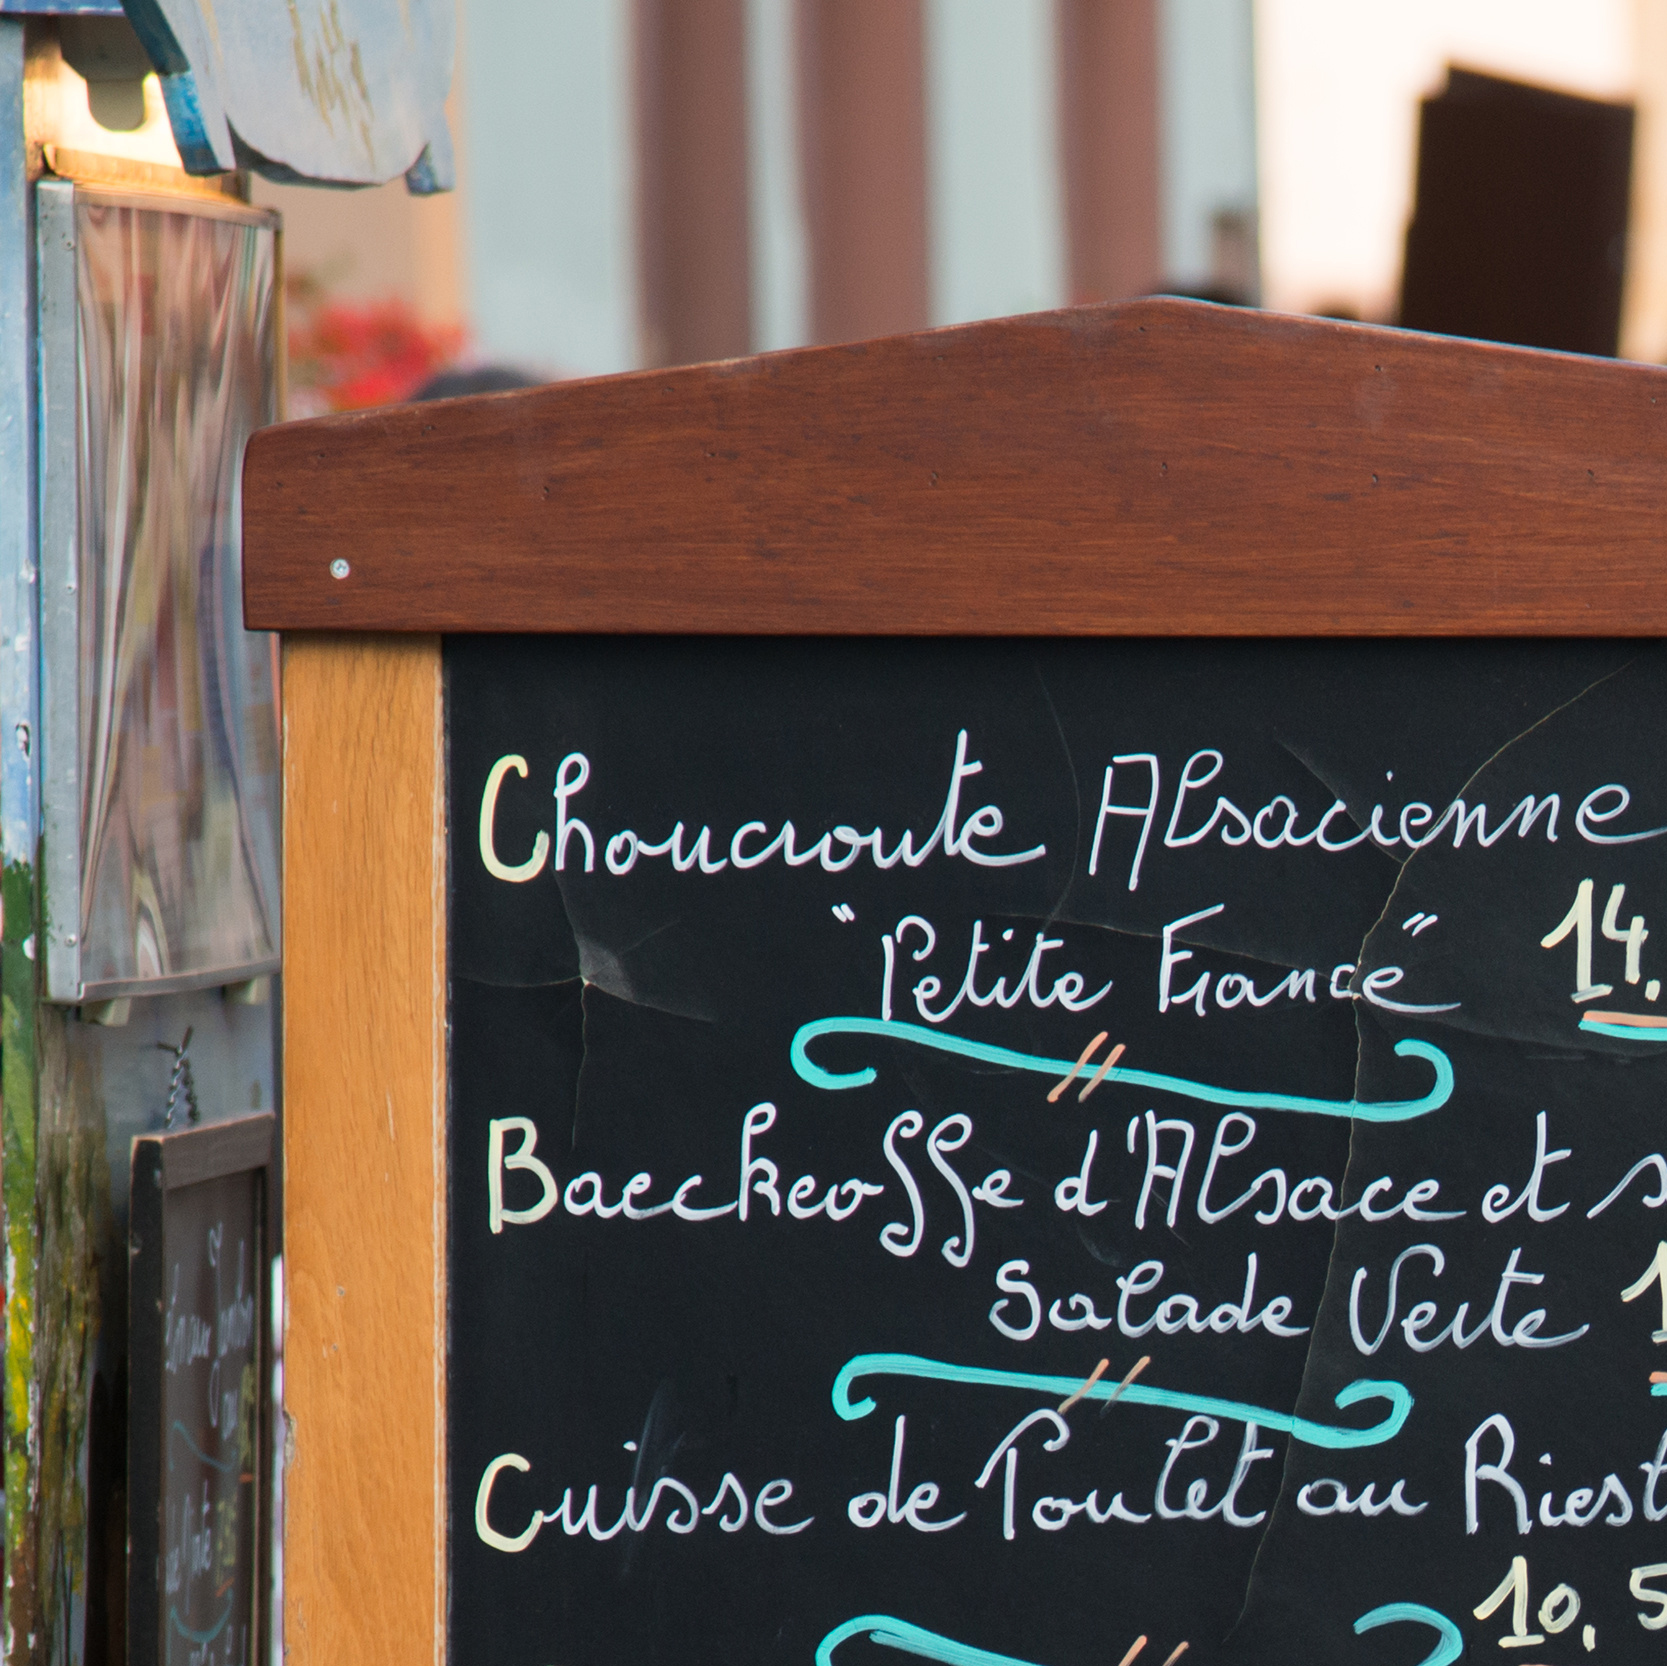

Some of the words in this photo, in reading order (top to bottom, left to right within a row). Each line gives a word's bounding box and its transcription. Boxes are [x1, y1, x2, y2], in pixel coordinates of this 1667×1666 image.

[480, 730, 1046, 881] Choucroute
[1482, 1110, 1573, 1224] et
[475, 1440, 815, 1553] Cuisse
[848, 1414, 968, 1536] de
[1296, 1478, 1430, 1518] au
